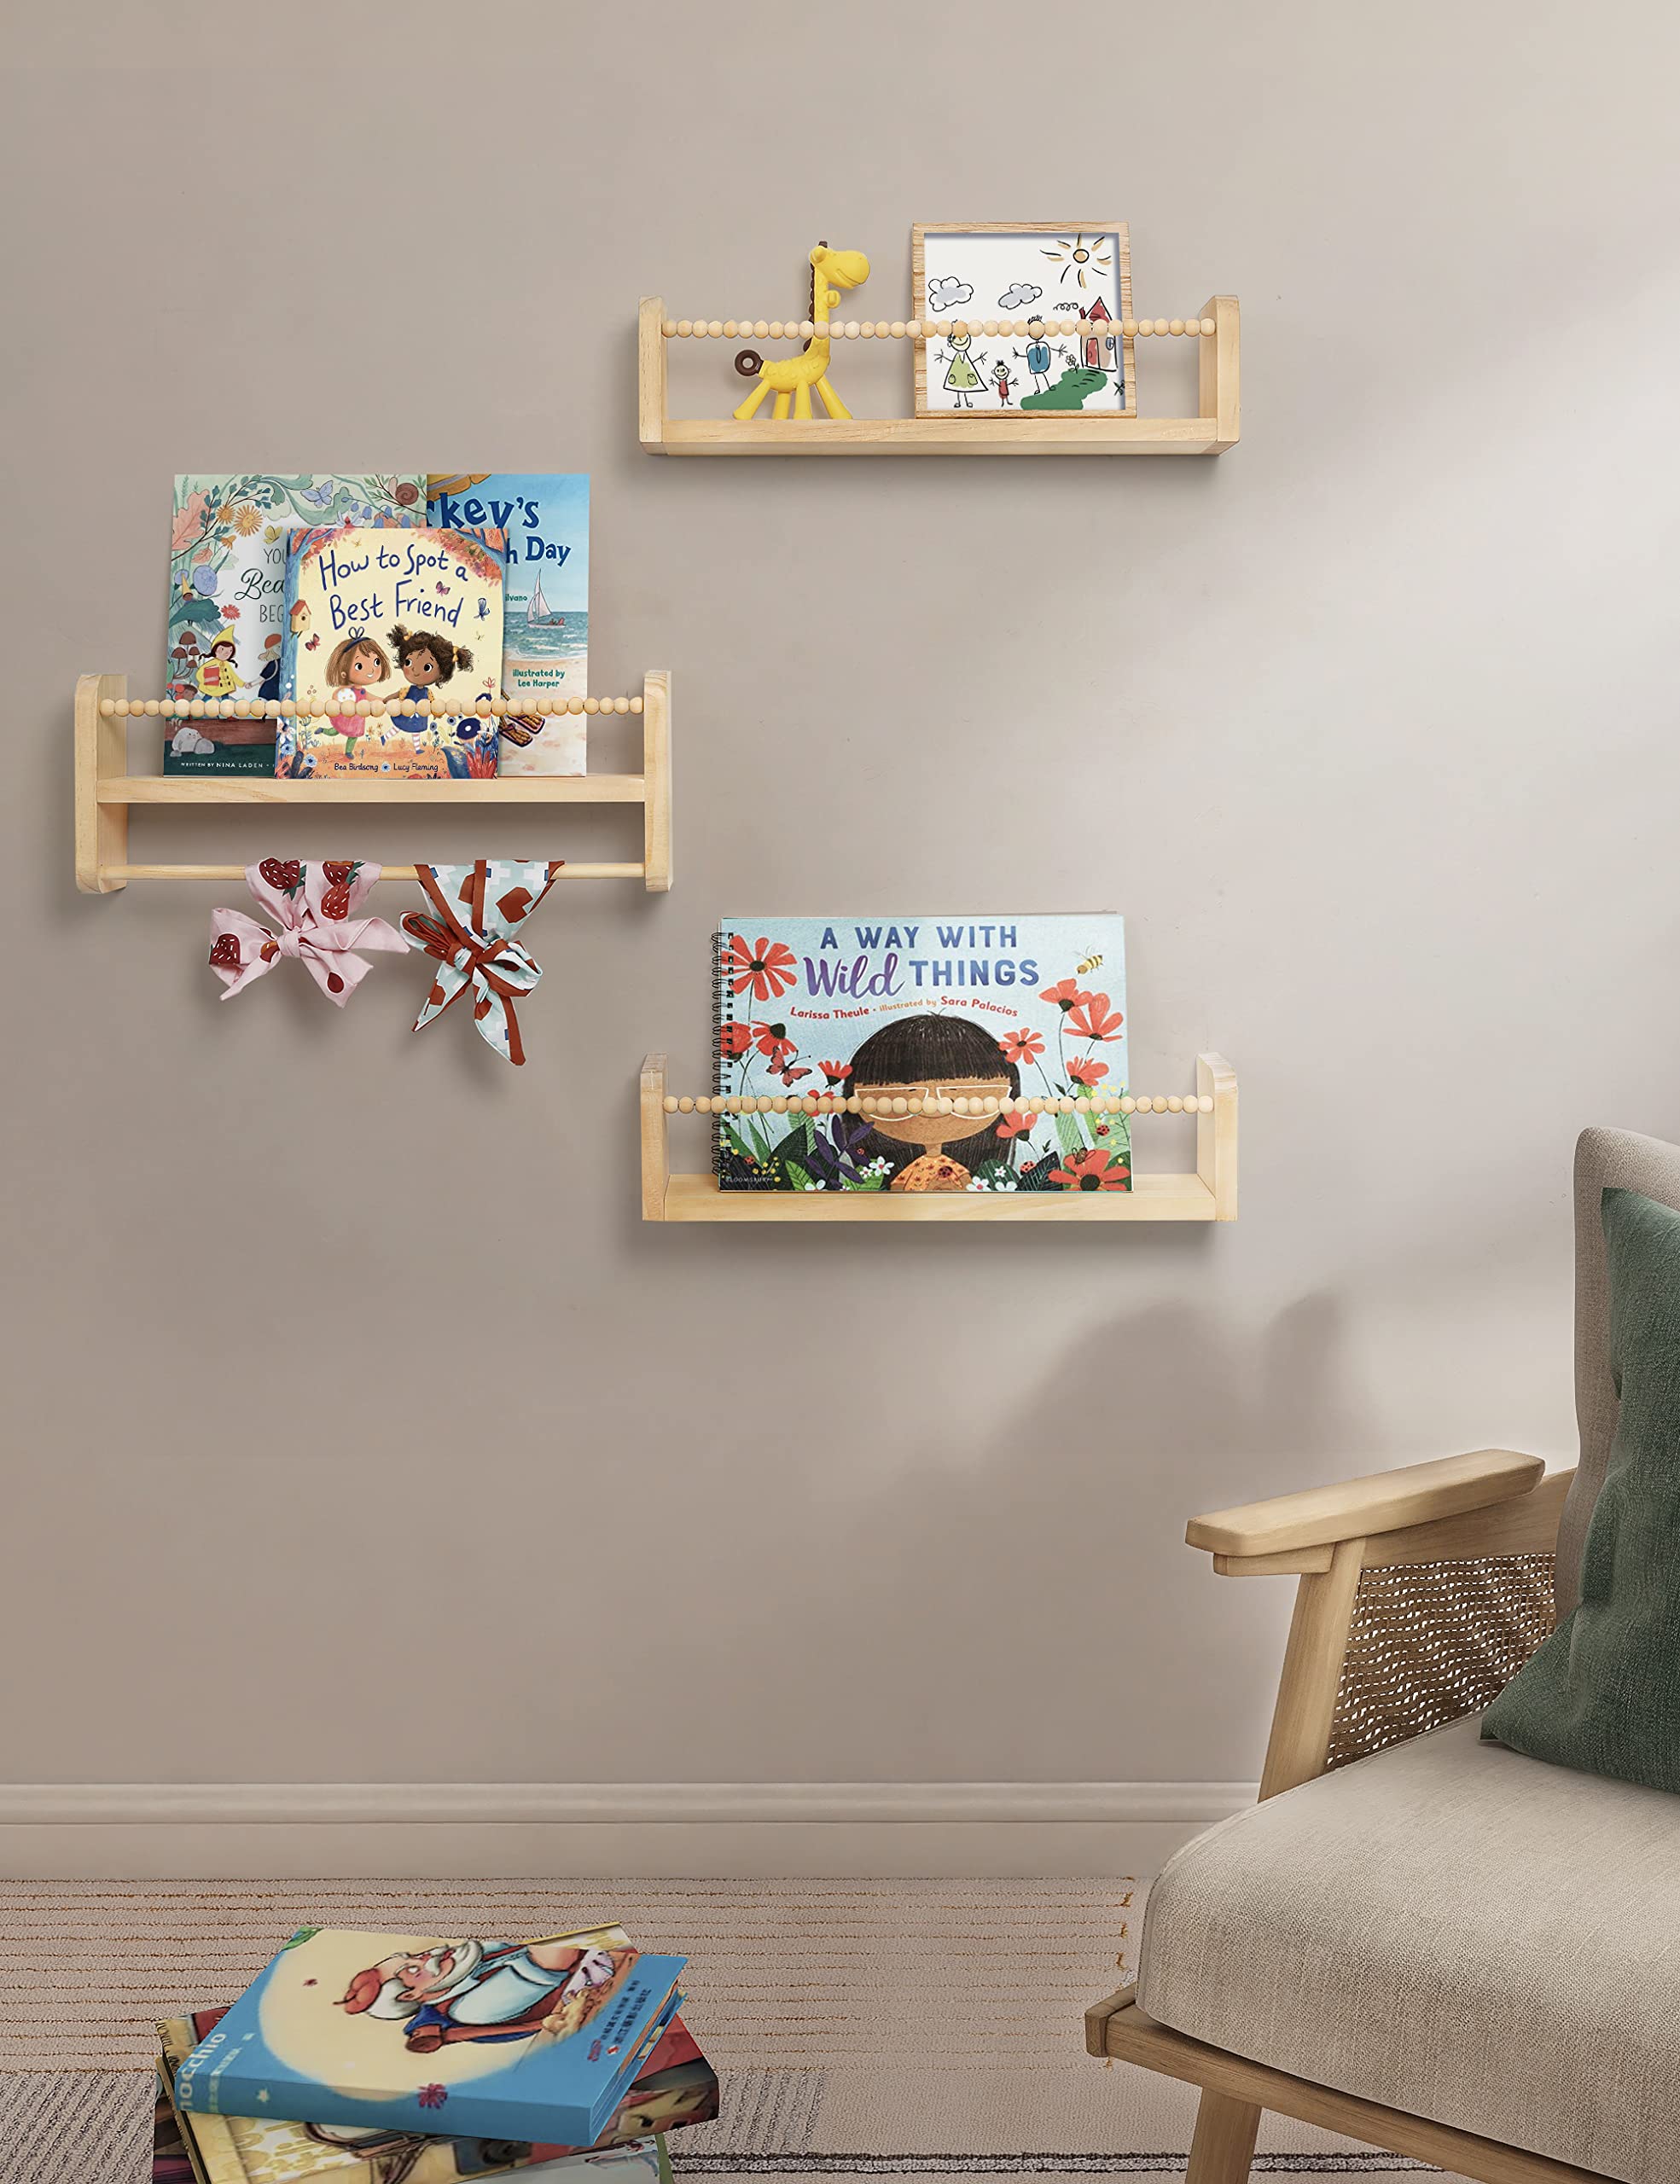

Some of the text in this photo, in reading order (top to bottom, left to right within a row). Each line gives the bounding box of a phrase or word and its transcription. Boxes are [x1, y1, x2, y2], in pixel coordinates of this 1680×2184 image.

[525, 536, 571, 566] Day
[319, 543, 468, 591] How to Spot a
[329, 579, 464, 630] Best Friend
[513, 669, 565, 679] illustrated by
[532, 679, 560, 689] Harper
[334, 763, 439, 772] Bea Birdsong Lucy Fleming
[820, 925, 1017, 950] A WAY WITH
[803, 952, 1040, 1000] Wild THINGS
[790, 995, 1019, 1019] Larissa Theule illustrated by Sara Palacios
